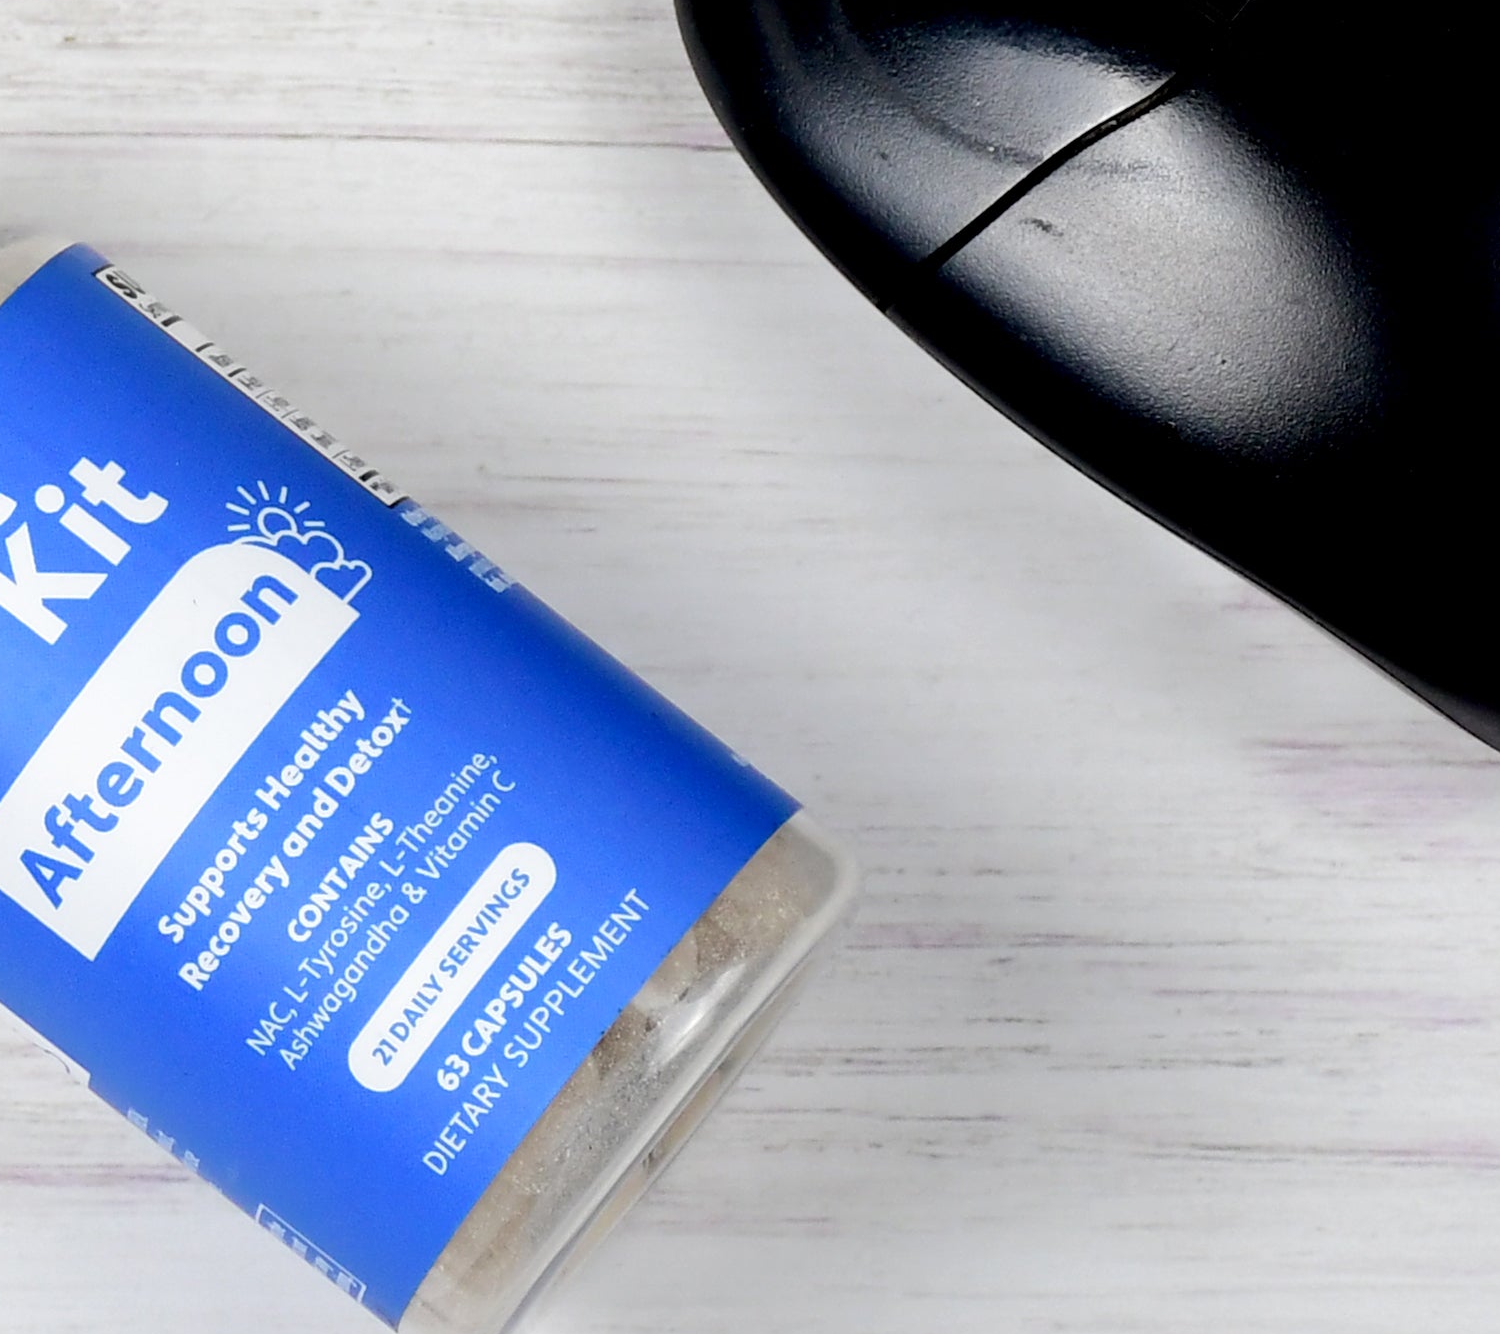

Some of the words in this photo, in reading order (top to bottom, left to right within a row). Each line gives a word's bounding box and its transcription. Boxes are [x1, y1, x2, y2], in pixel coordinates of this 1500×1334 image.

[19, 574, 299, 910] Afternoon
[157, 807, 269, 944] Supports
[254, 689, 365, 811] Healthy
[178, 839, 304, 991] Recovery
[289, 787, 339, 848] and
[246, 1001, 298, 1055] NAC,
[283, 882, 392, 1003] L-Tyrosine,
[379, 753, 497, 888] L-Theanine,
[280, 904, 410, 1070] Ashwagandha
[401, 882, 427, 904] &
[415, 793, 501, 879] Vitamin
[492, 771, 515, 792] C
[287, 812, 394, 943] CONTAINS
[372, 1038, 398, 1066] 21
[389, 974, 443, 1042] DAILY
[439, 868, 530, 978] SERVINGS
[423, 1063, 509, 1175] DIETARY
[503, 888, 649, 1068] SUPPLEMENT
[436, 1053, 470, 1092] 63
[461, 922, 572, 1057] CAPSULES
